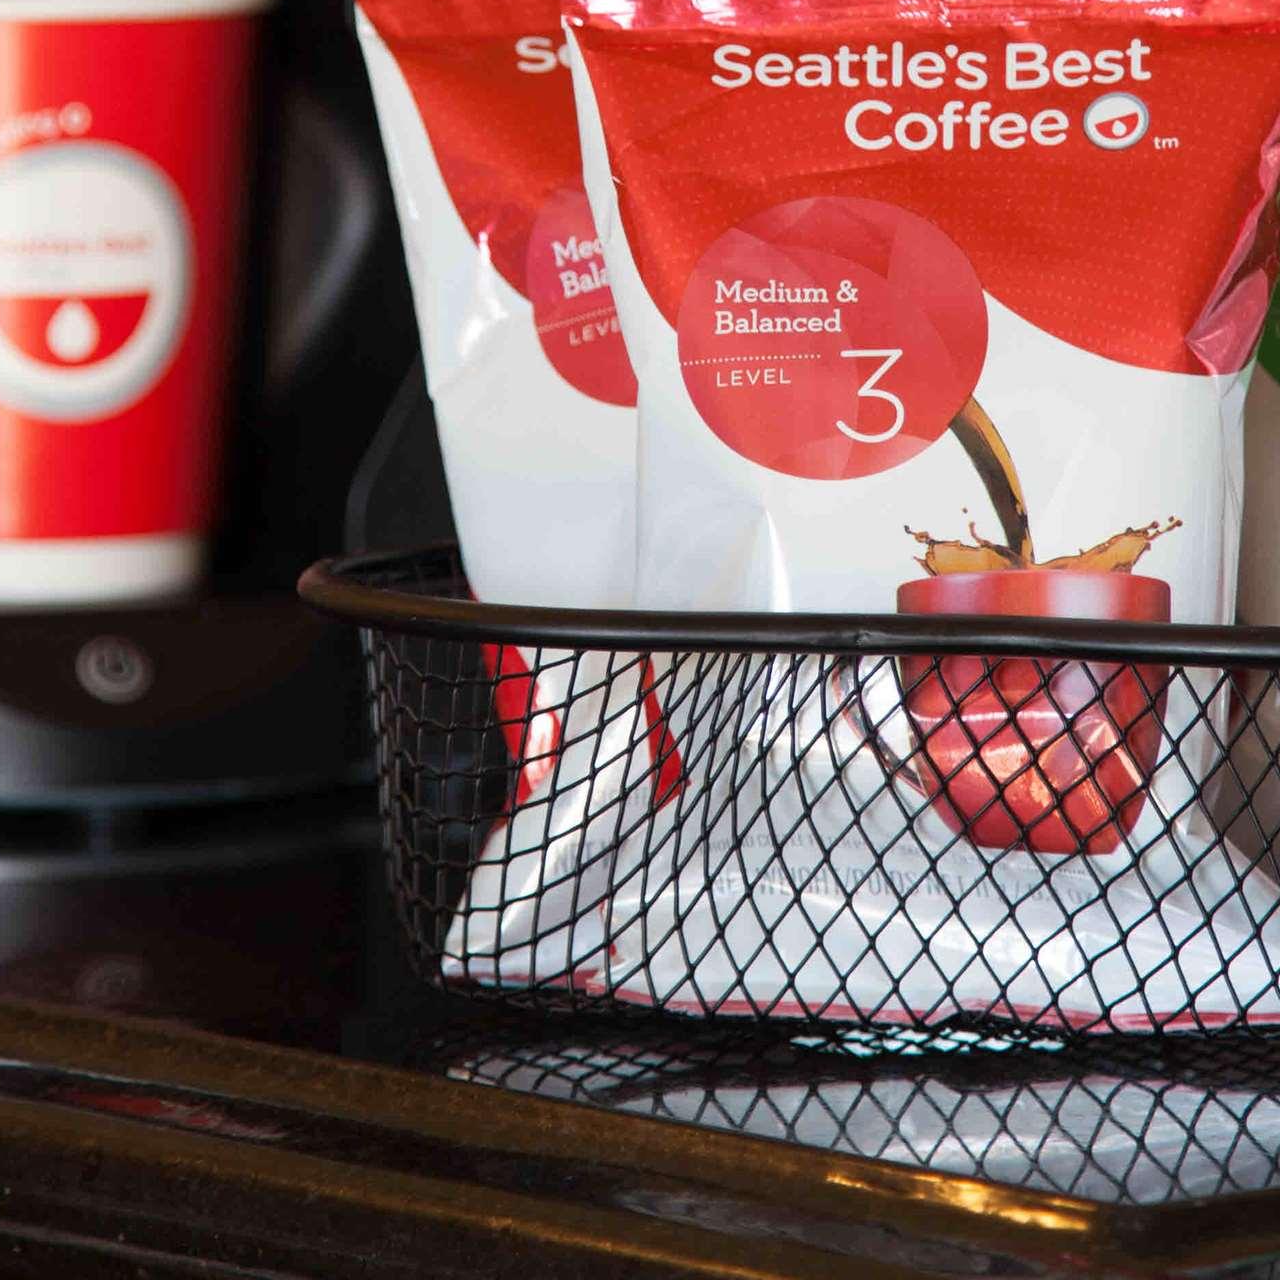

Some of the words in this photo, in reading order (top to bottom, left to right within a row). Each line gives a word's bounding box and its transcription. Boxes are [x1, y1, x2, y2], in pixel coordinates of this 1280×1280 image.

[710, 40, 988, 90] Seattle's
[1004, 38, 1153, 91] Best
[844, 98, 1069, 151] Coffee
[714, 279, 829, 304] Medium
[835, 279, 859, 304] &
[714, 308, 843, 335] Balanced
[716, 367, 791, 388] LEVEL
[835, 348, 905, 444] 3
